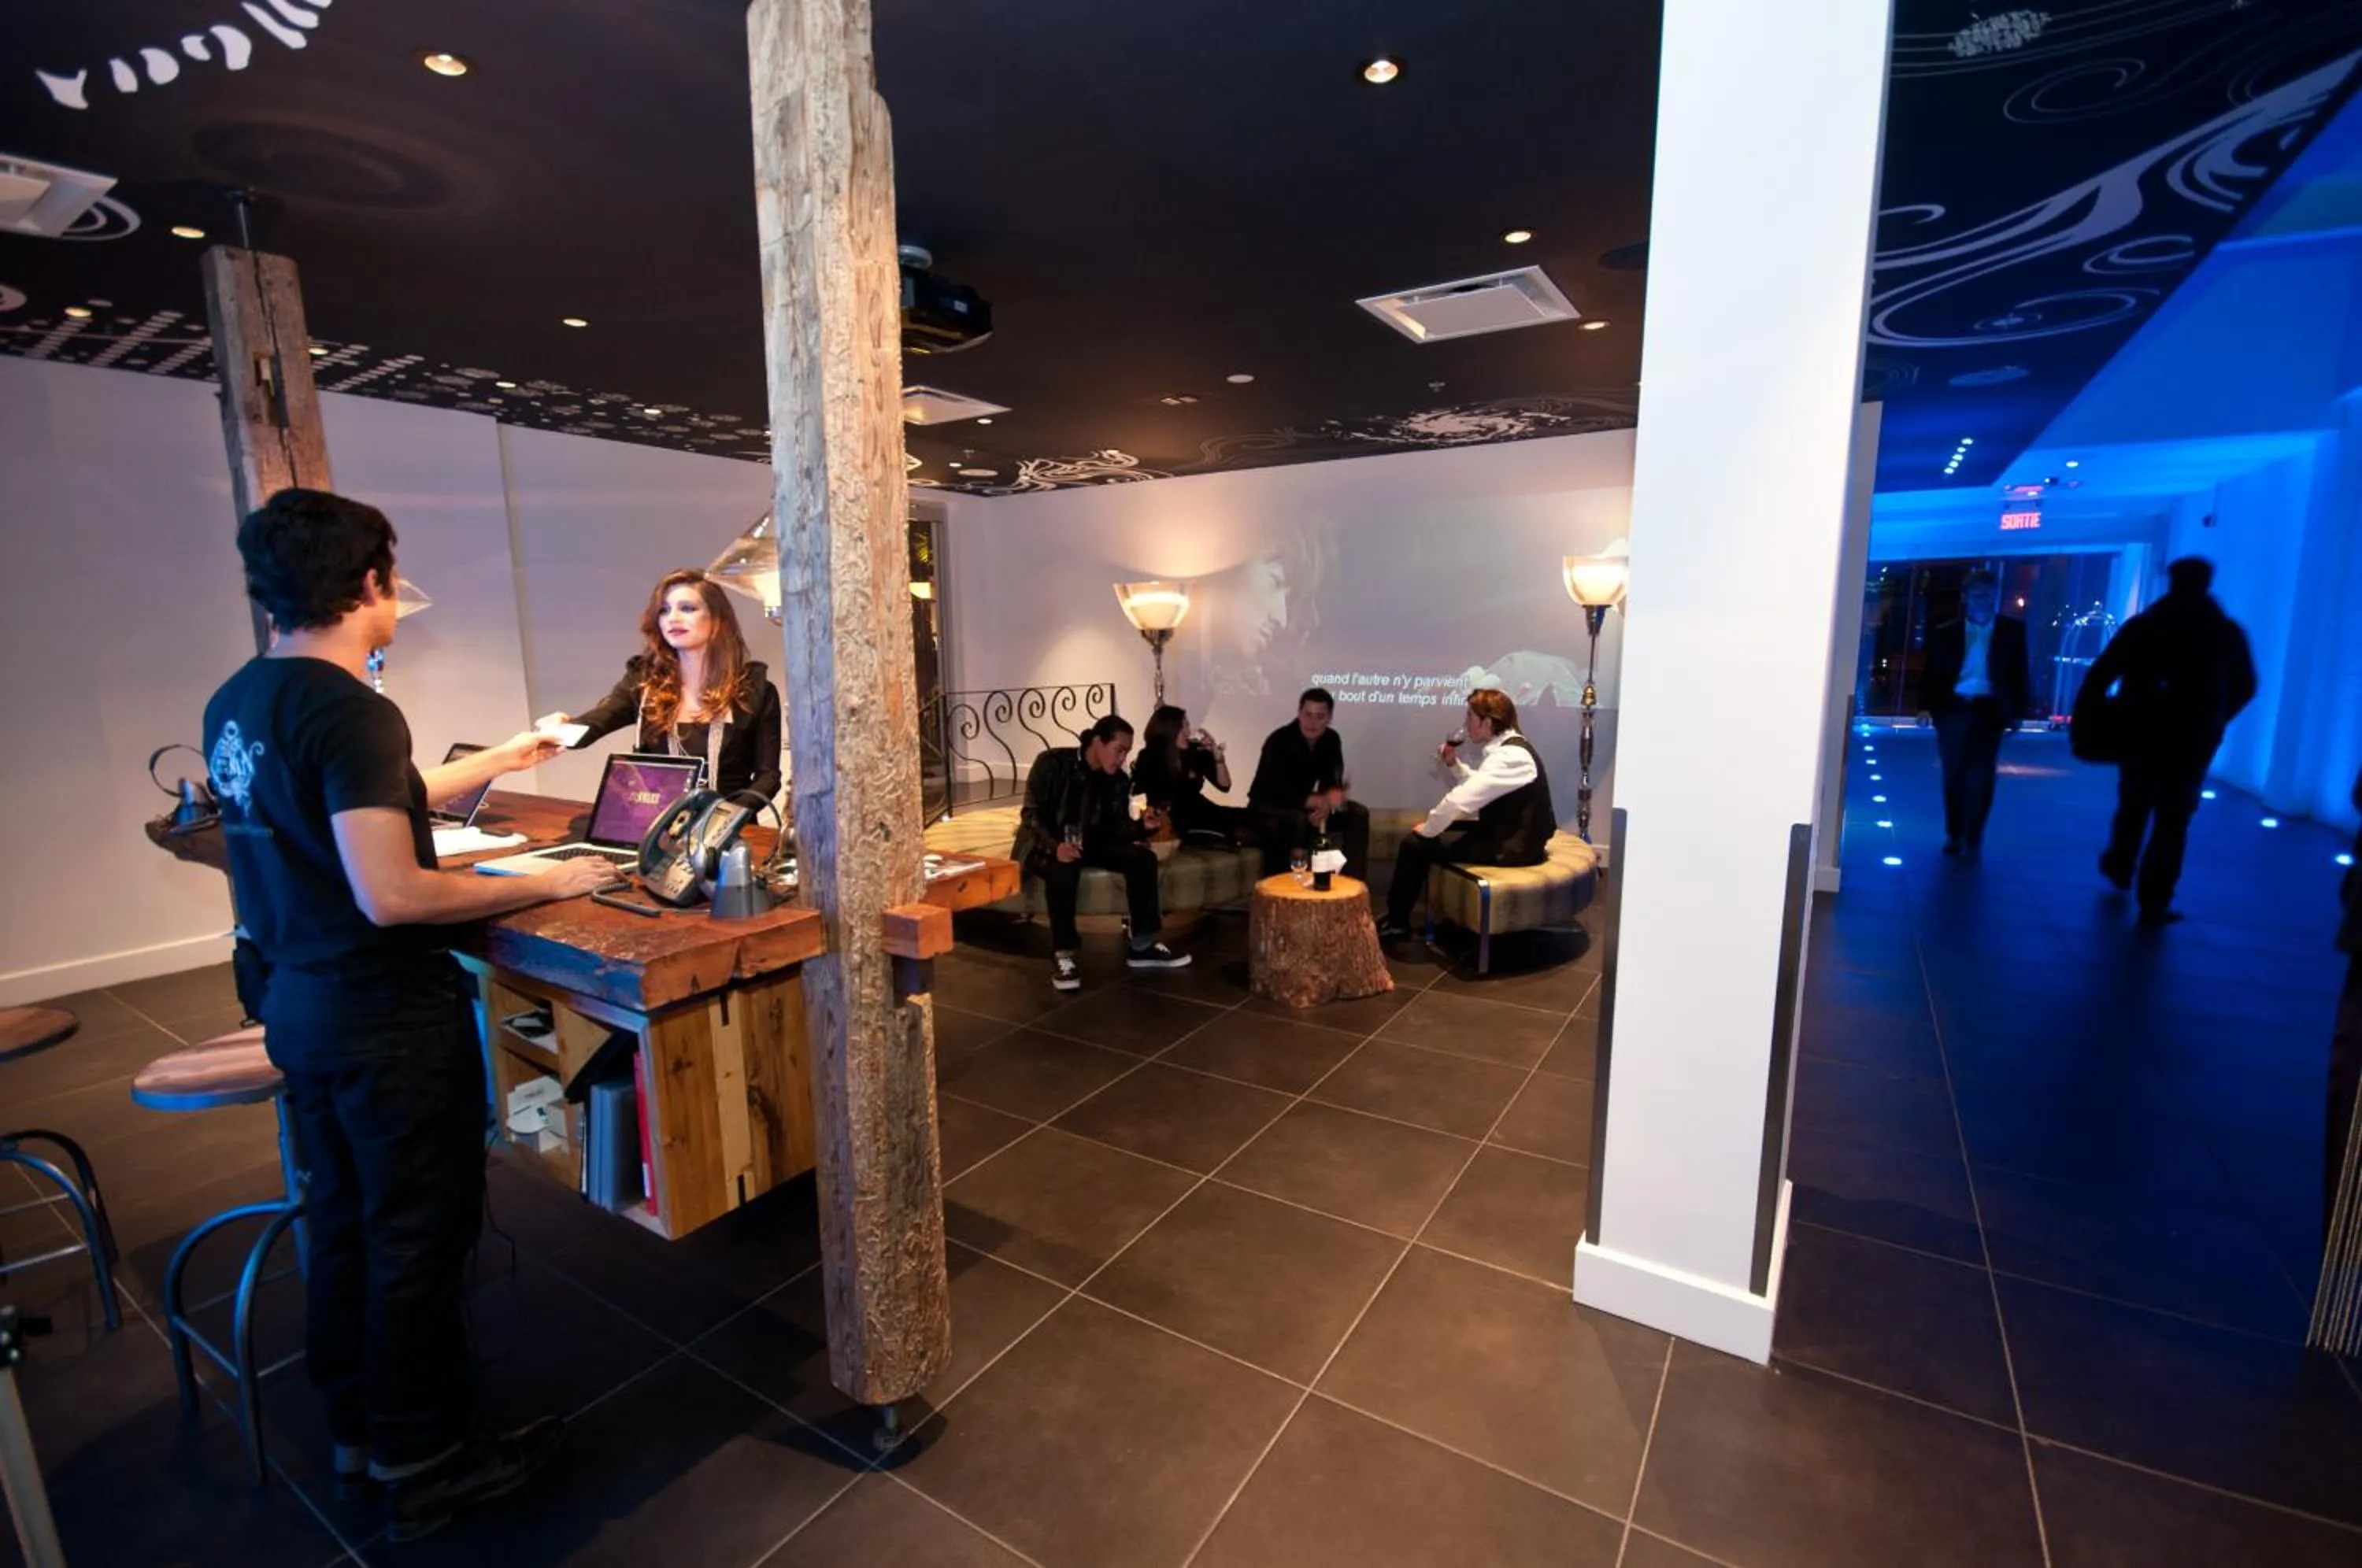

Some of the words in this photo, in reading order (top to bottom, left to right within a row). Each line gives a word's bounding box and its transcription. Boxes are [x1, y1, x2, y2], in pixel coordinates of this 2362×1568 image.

[2001, 512, 2042, 530] SORTIE
[1312, 671, 1350, 686] quand
[1352, 671, 1390, 686] l'autre
[1393, 672, 1412, 690] n'y
[1414, 675, 1468, 690] parvient
[1339, 690, 1366, 703] bout
[1368, 690, 1394, 704] d'un
[1398, 691, 1437, 708] temps
